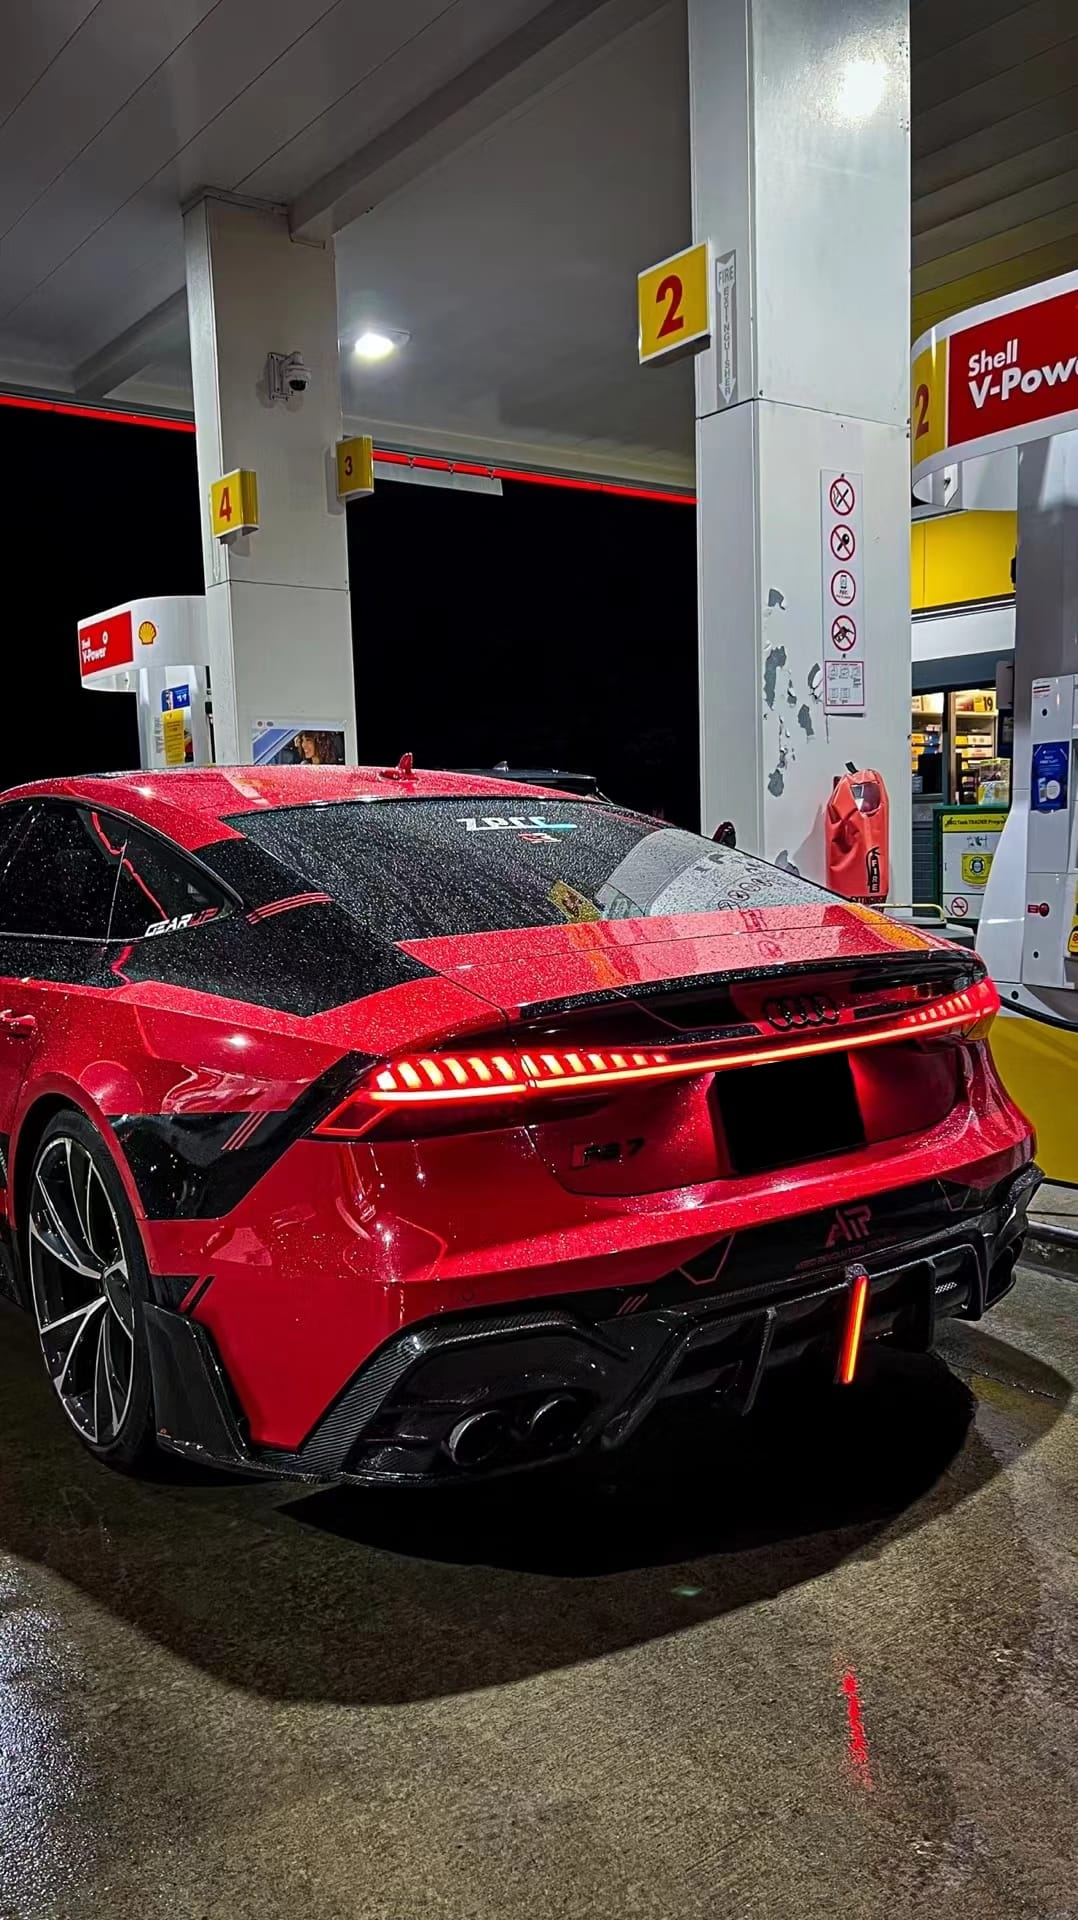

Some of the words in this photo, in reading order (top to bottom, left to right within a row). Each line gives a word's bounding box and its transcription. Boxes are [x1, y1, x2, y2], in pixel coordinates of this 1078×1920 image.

[718, 265, 734, 287] FIRE
[655, 274, 685, 339] 2
[968, 338, 1018, 377] Shell
[968, 356, 1078, 409] V-Pow
[915, 383, 930, 441] 2
[344, 455, 353, 477] 3
[218, 486, 232, 522] 4
[871, 859, 879, 891] FIRE
